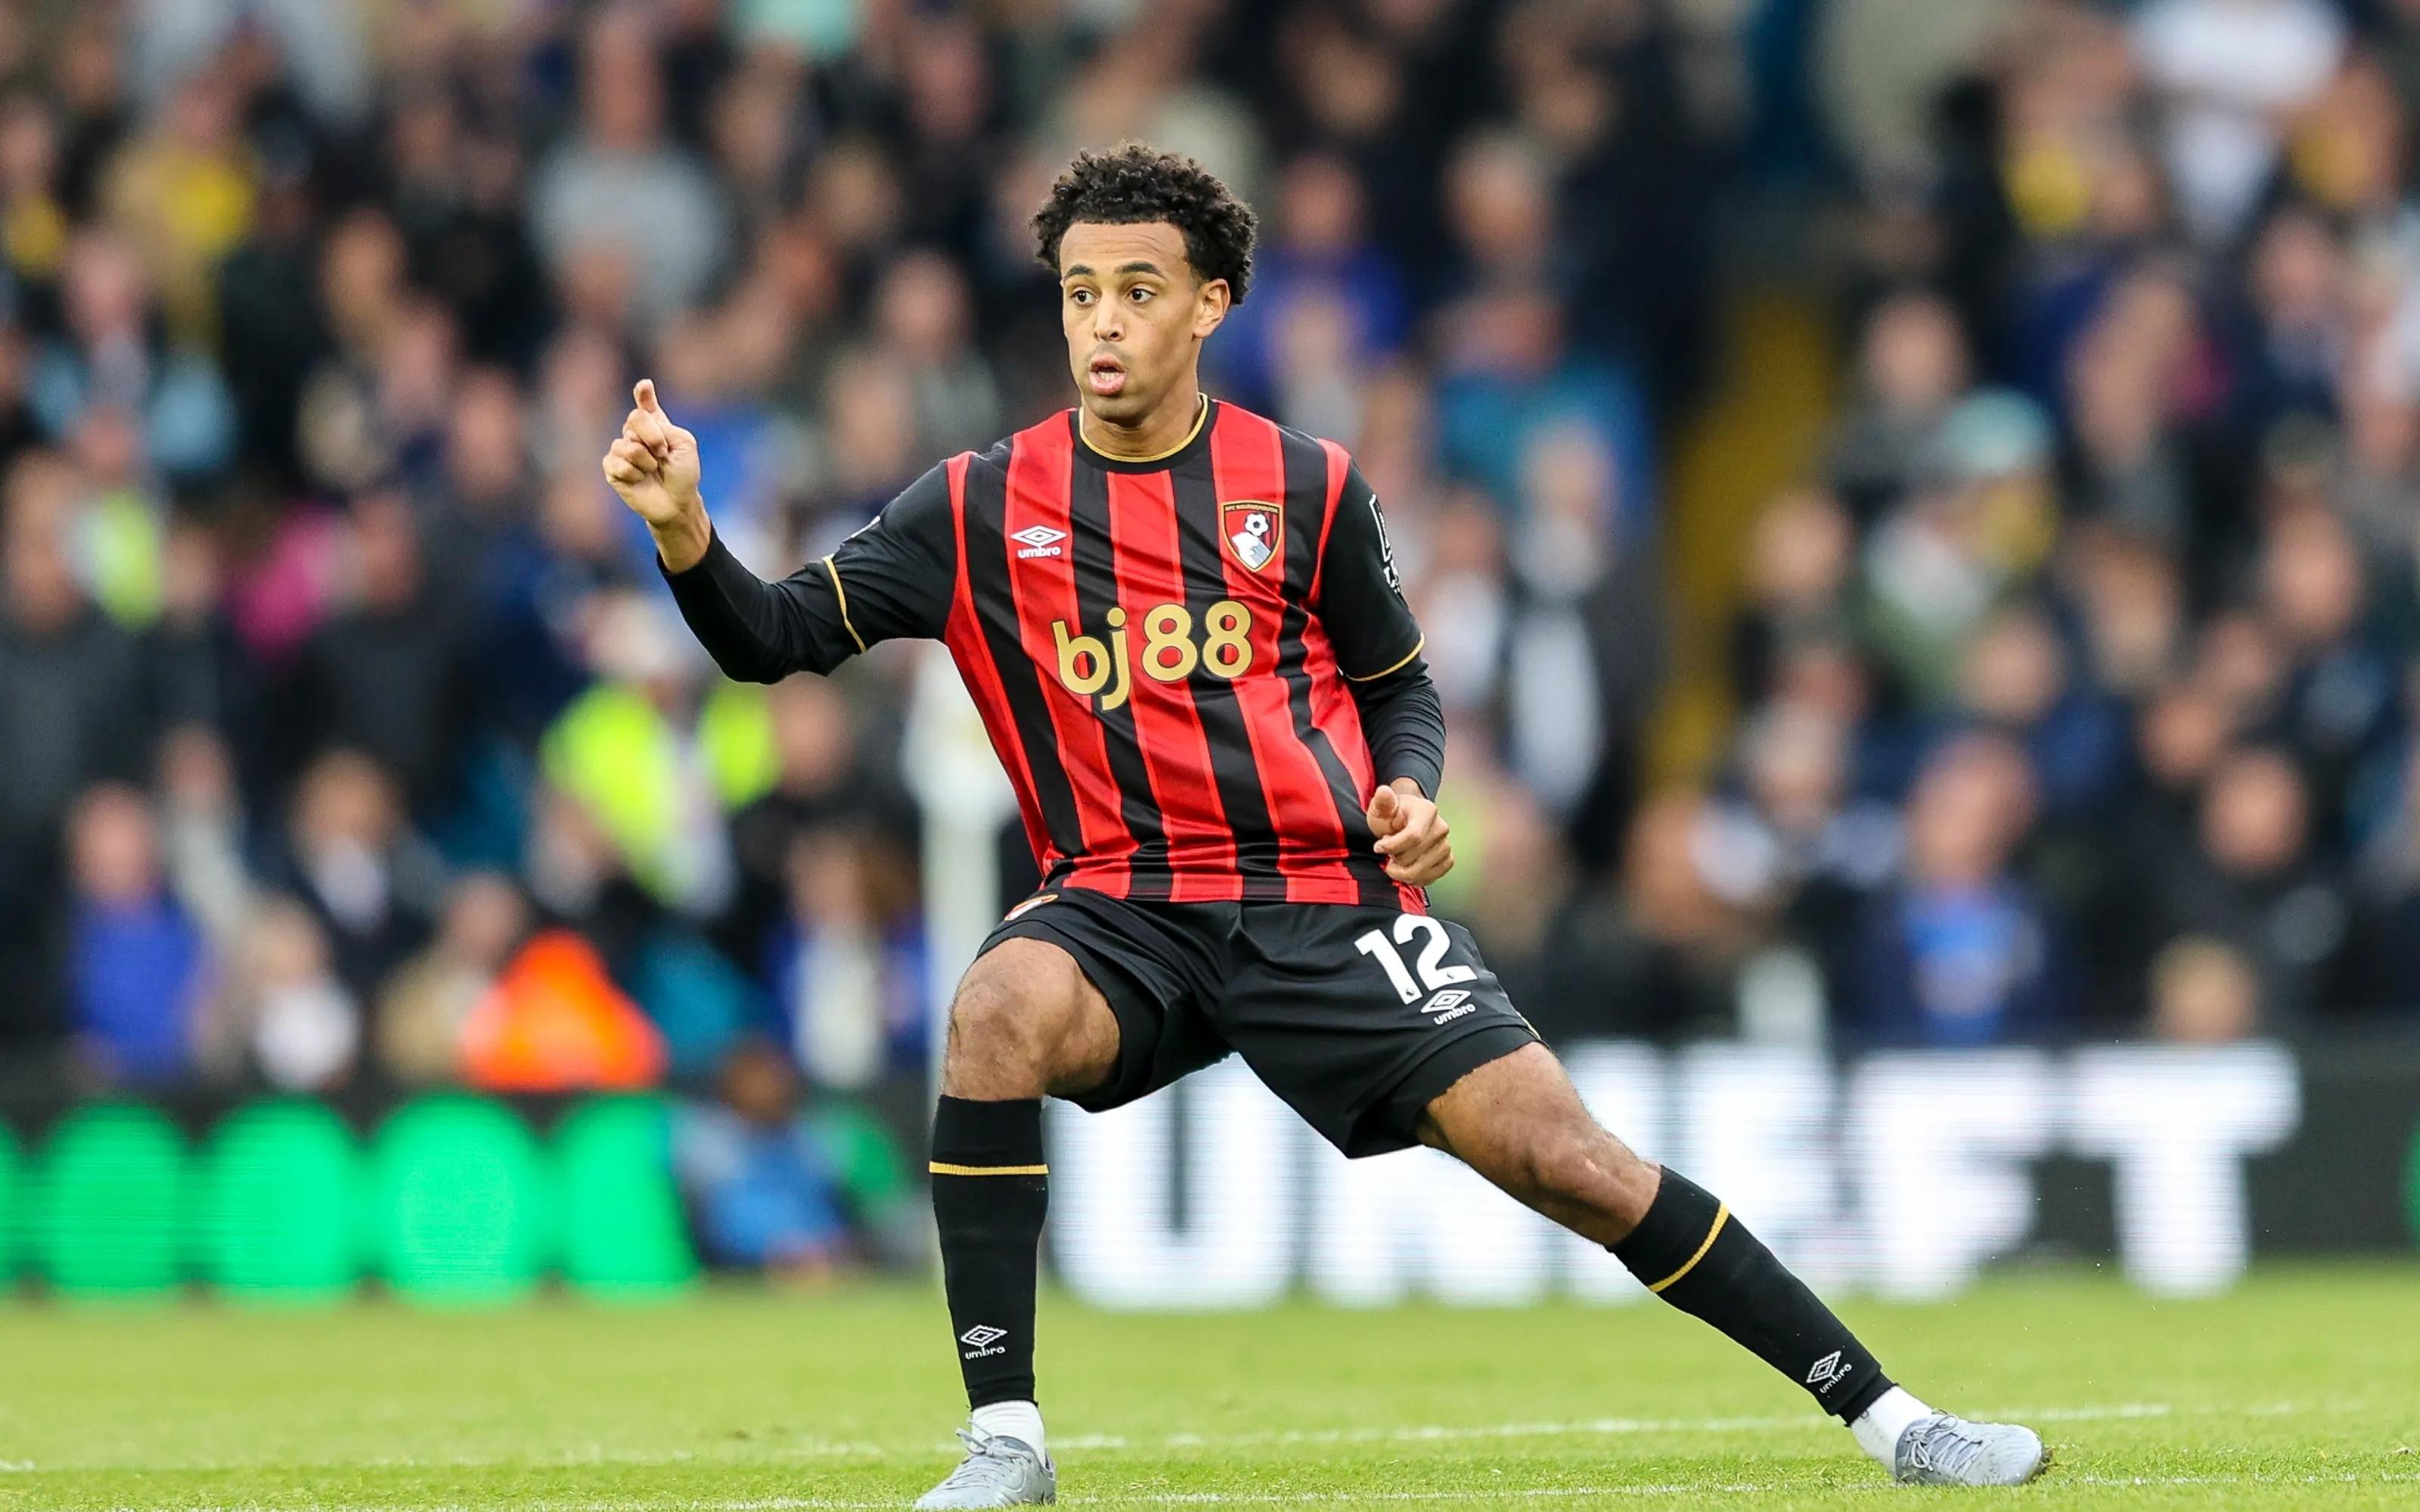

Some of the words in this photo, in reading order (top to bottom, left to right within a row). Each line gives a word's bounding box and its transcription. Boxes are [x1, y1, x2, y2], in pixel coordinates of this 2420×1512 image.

[1017, 546, 1061, 559] umbro
[1052, 600, 1252, 711] bj88
[1354, 912, 1478, 1005] 12
[1433, 1003, 1476, 1025] umbro
[965, 1346, 1006, 1360] umbro
[1819, 1363, 1852, 1394] umbro
